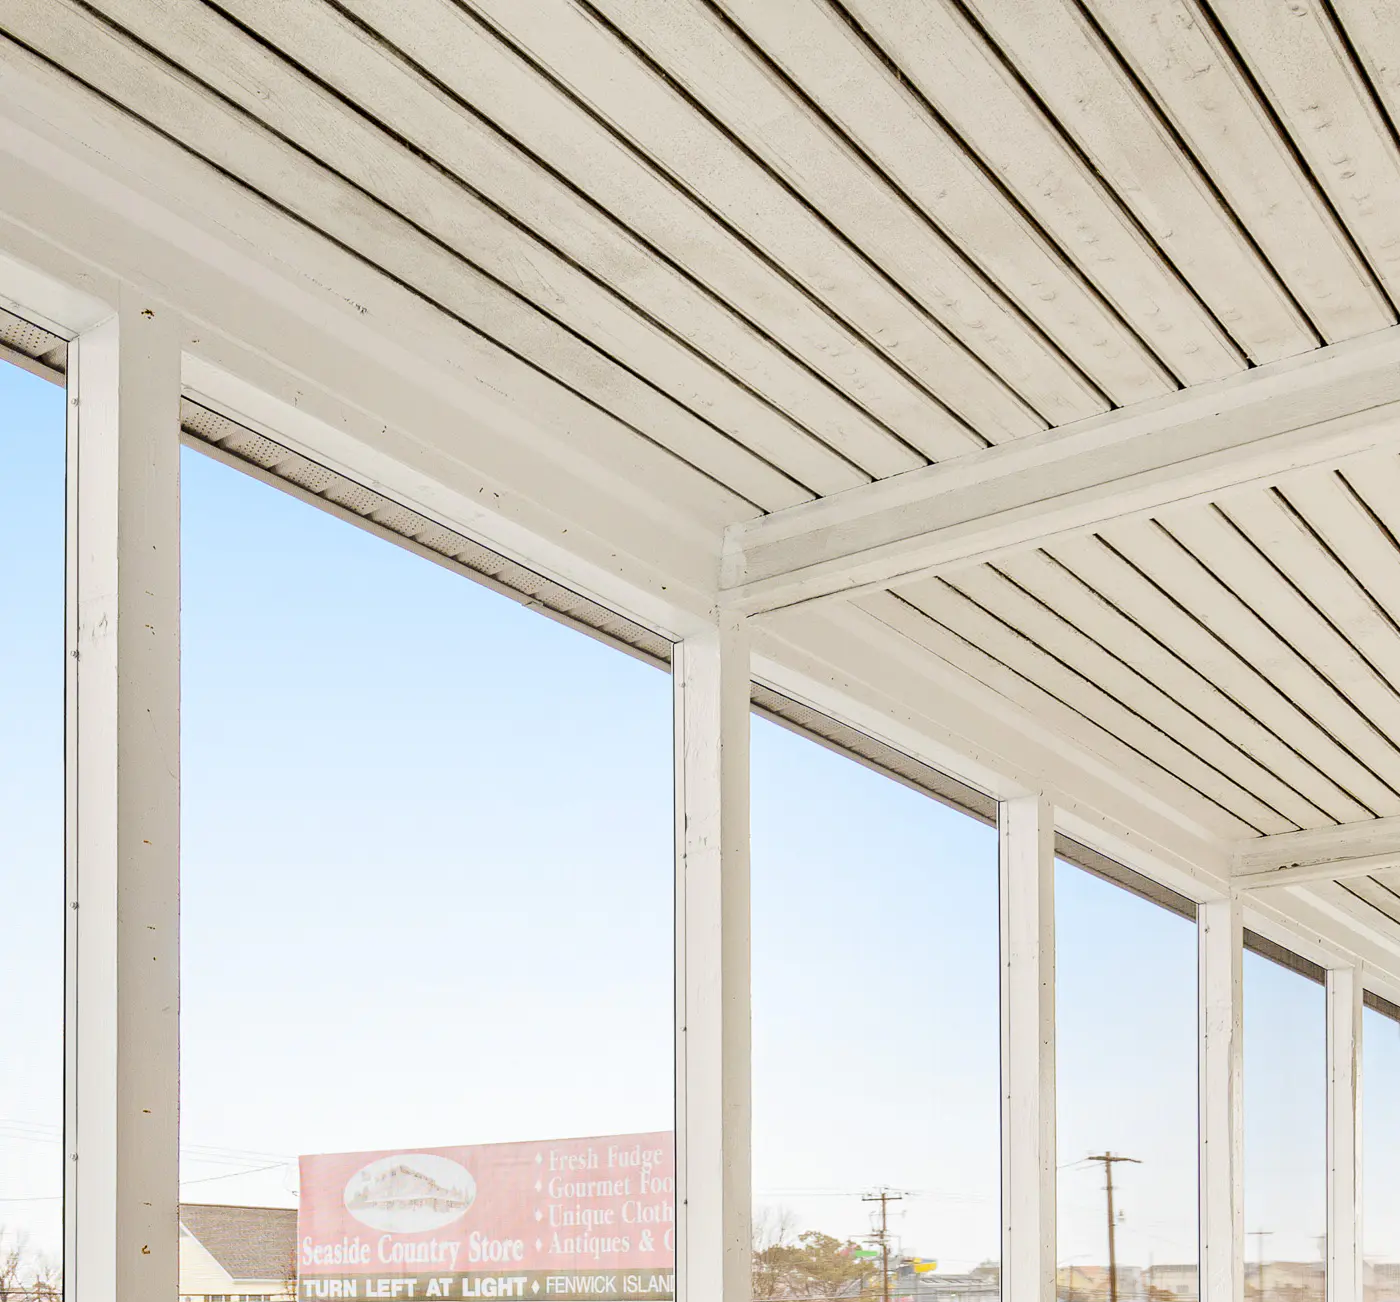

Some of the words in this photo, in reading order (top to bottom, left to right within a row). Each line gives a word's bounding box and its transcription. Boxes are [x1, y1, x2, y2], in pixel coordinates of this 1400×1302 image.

[549, 1147, 599, 1171] Fresh
[608, 1145, 663, 1174] Fudge
[548, 1176, 632, 1198] Gourmet
[548, 1204, 614, 1231] Unique
[302, 1236, 371, 1265] Seaside
[377, 1234, 460, 1270] Country
[468, 1231, 525, 1262] Store
[548, 1231, 630, 1259] Antiques
[638, 1229, 655, 1252] &
[303, 1279, 357, 1297] TURN
[366, 1279, 418, 1297] LEFT
[426, 1278, 452, 1296] AT
[462, 1277, 528, 1296] LIGHT
[546, 1275, 617, 1293] FENWICK
